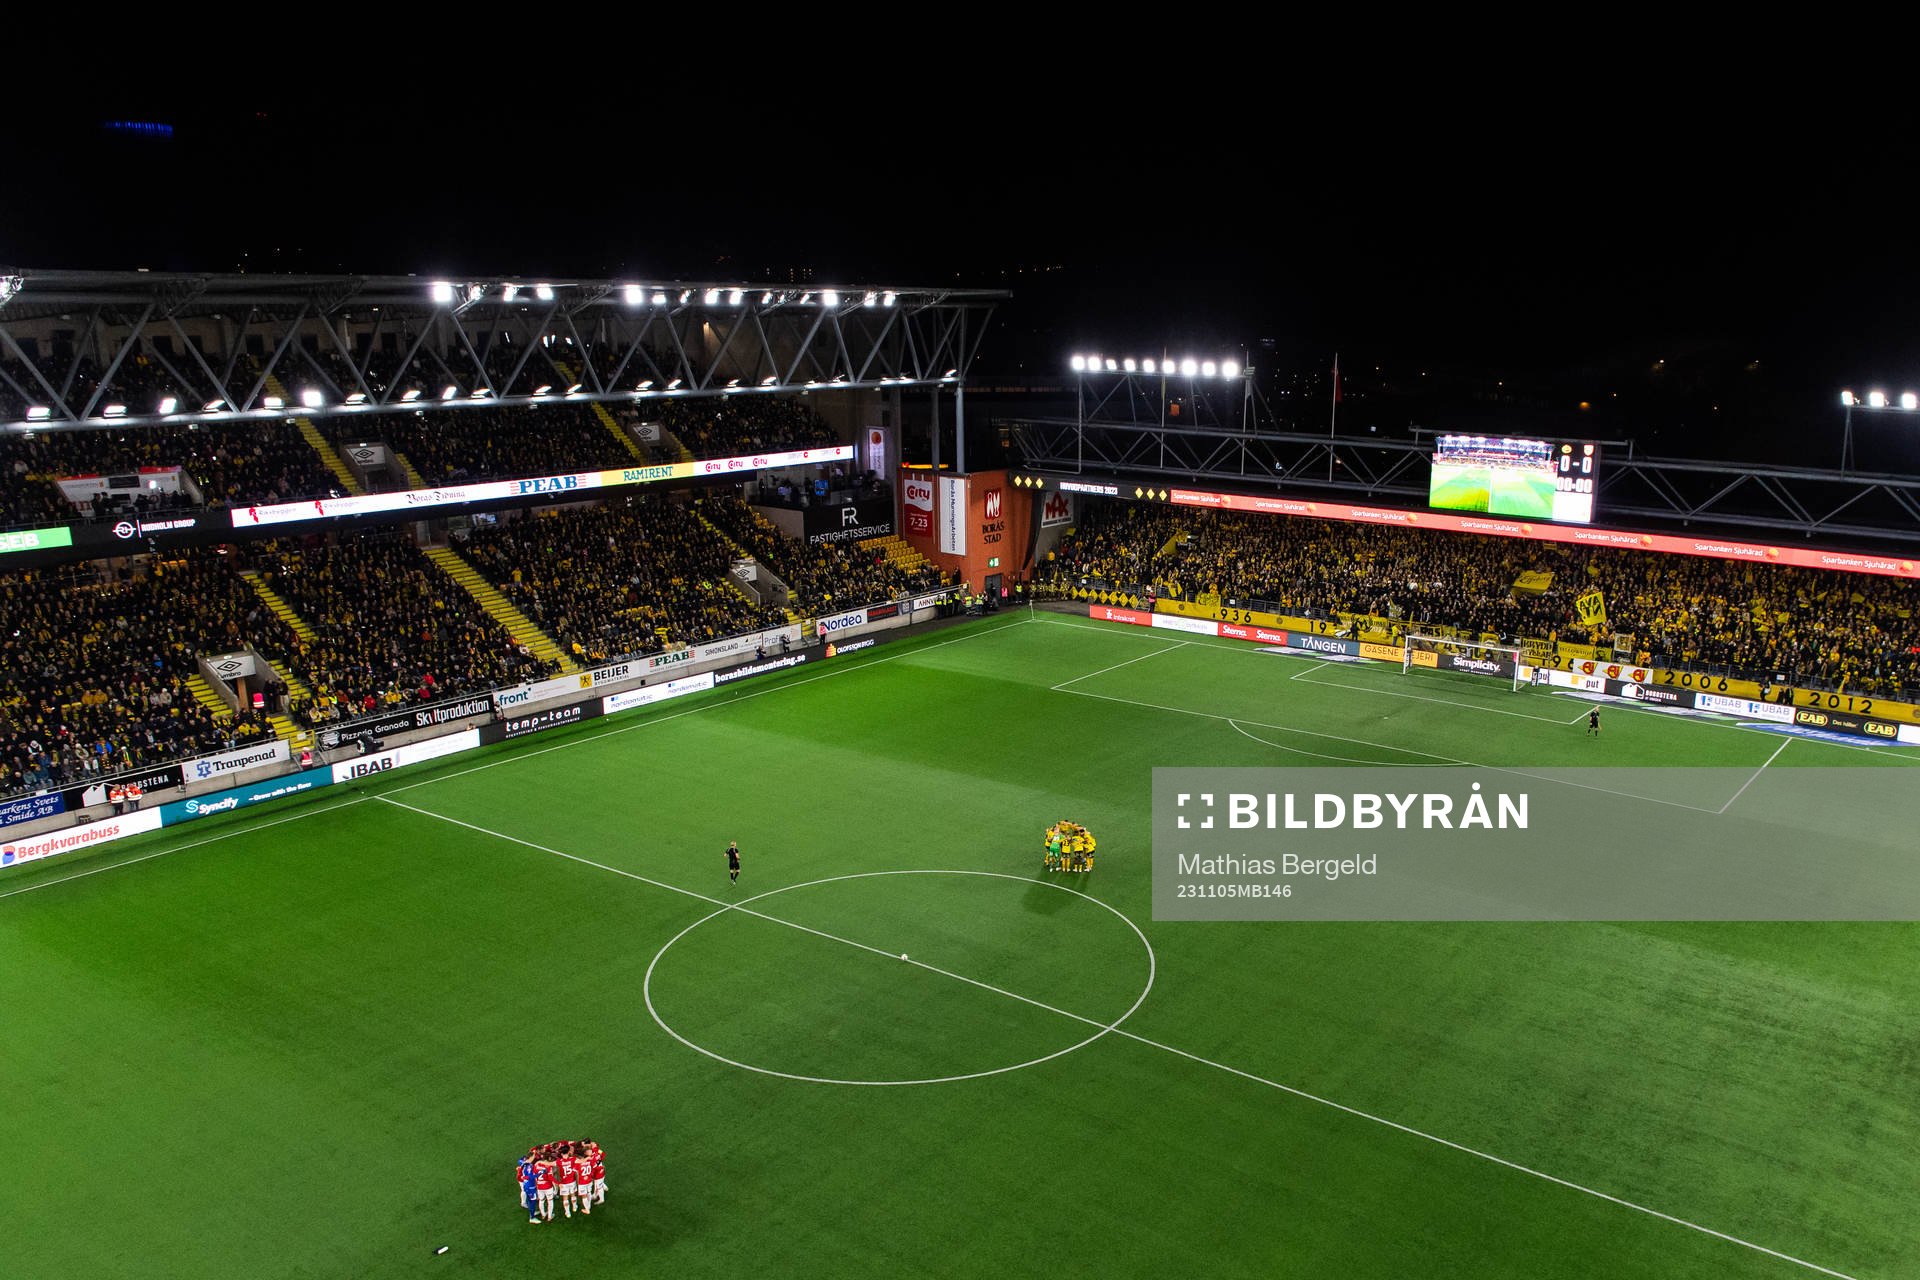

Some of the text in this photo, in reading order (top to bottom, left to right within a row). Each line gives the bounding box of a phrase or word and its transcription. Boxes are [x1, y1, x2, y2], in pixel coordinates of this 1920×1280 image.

[1560, 455, 1570, 472] 0
[1582, 457, 1592, 474] 0
[623, 466, 674, 481] RAMIRENT
[518, 475, 578, 494] PEAB
[1045, 491, 1069, 520] MAX
[910, 517, 928, 528] 7-23
[982, 520, 1005, 535] BORÅS
[809, 523, 891, 545] FASTIGHETSSERVICE
[984, 534, 1002, 545] STAD
[1694, 543, 1732, 554] Sparbanken
[1822, 555, 1863, 567] Sparbanken
[822, 615, 863, 632] Nordea
[704, 642, 739, 657] SIMONSLAND
[1300, 635, 1346, 654] TÅNGEN
[1364, 645, 1399, 657] GASENE
[655, 649, 690, 667] PEAB
[594, 665, 629, 681] BEIJER
[1664, 670, 1729, 692] 2006
[1585, 679, 1600, 690] put
[498, 691, 529, 706] front
[1714, 698, 1742, 708] UBAB
[1809, 692, 1873, 714] 2012
[1761, 704, 1790, 716] UBAB
[506, 706, 581, 732] temp-team
[1799, 712, 1826, 726] EAB
[1866, 722, 1894, 736] EAB
[213, 748, 276, 772] Tranpenad
[121, 774, 169, 791] BGSTENA
[32, 796, 59, 808] Svets
[5, 811, 36, 825] Smide
[36, 805, 54, 818] AB
[18, 824, 120, 859] Bergkvarabuss
[562, 1165, 573, 1176] 15
[580, 1165, 592, 1177] 20
